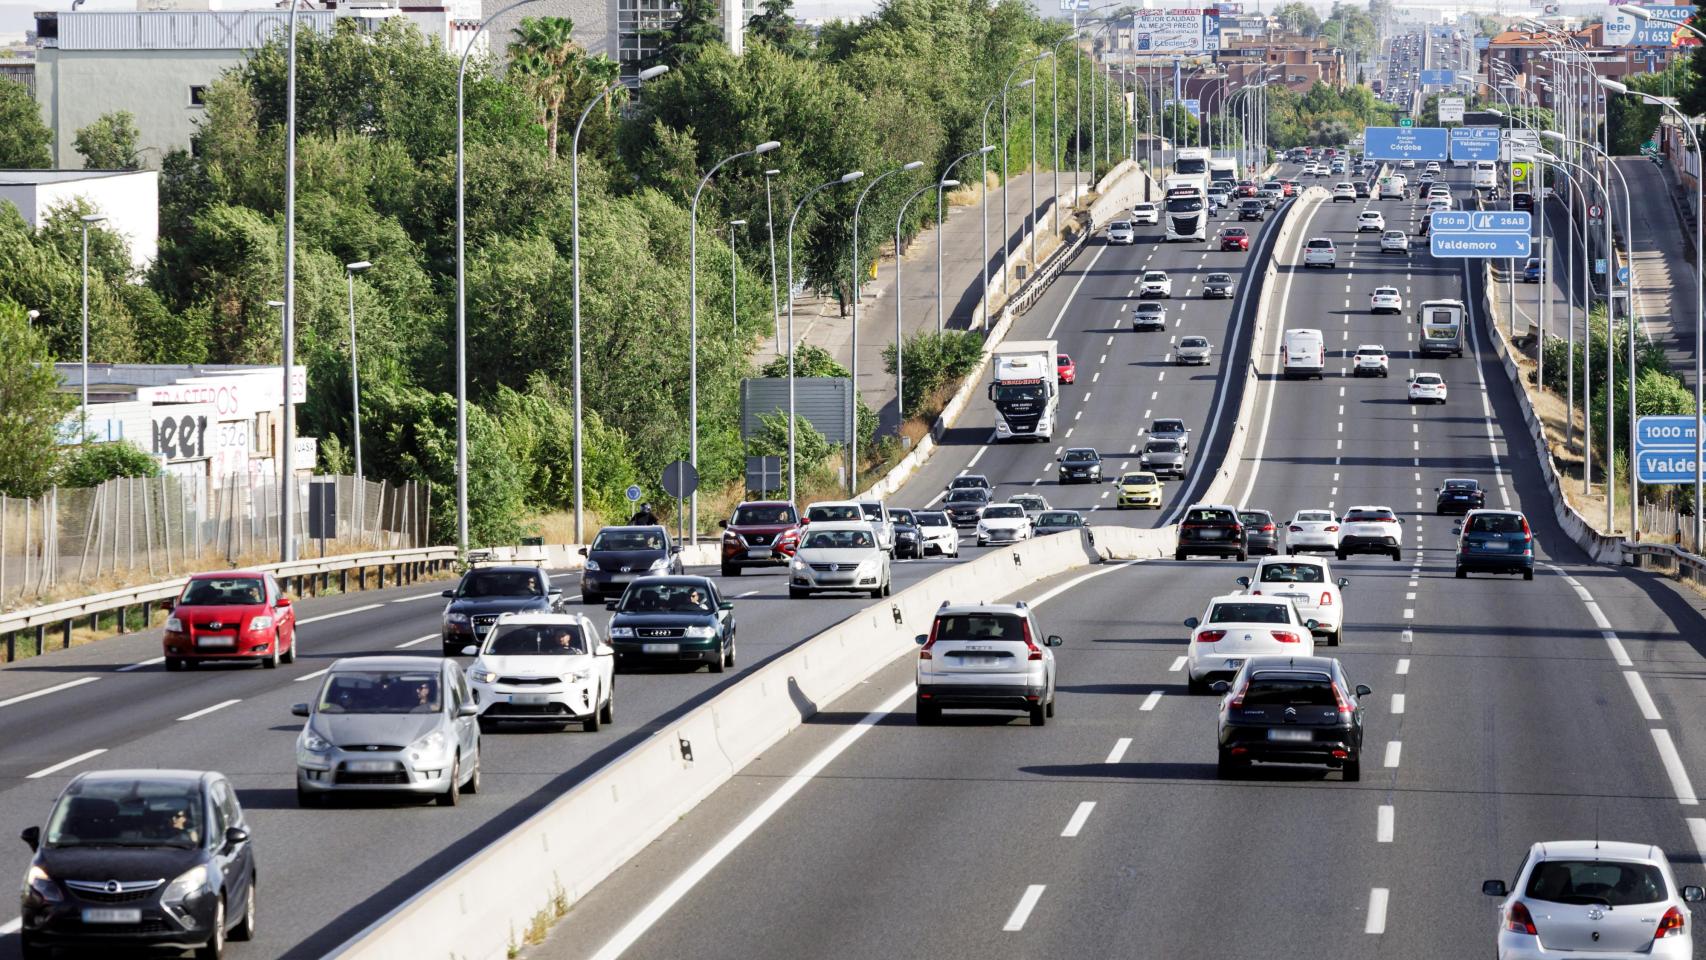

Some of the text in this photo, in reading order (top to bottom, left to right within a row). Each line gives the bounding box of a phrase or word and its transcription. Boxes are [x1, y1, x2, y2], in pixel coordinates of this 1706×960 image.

[1650, 9, 1689, 18] SPACIO
[1606, 22, 1631, 32] iepe
[1638, 31, 1669, 42] 91 653
[1390, 143, 1422, 151] Córdoba
[1437, 217, 1455, 225] 750
[1501, 217, 1525, 225] 26AB
[1437, 240, 1497, 250] Valdemoro
[1646, 426, 1697, 438] 1000 m
[1646, 458, 1706, 473] Valde
